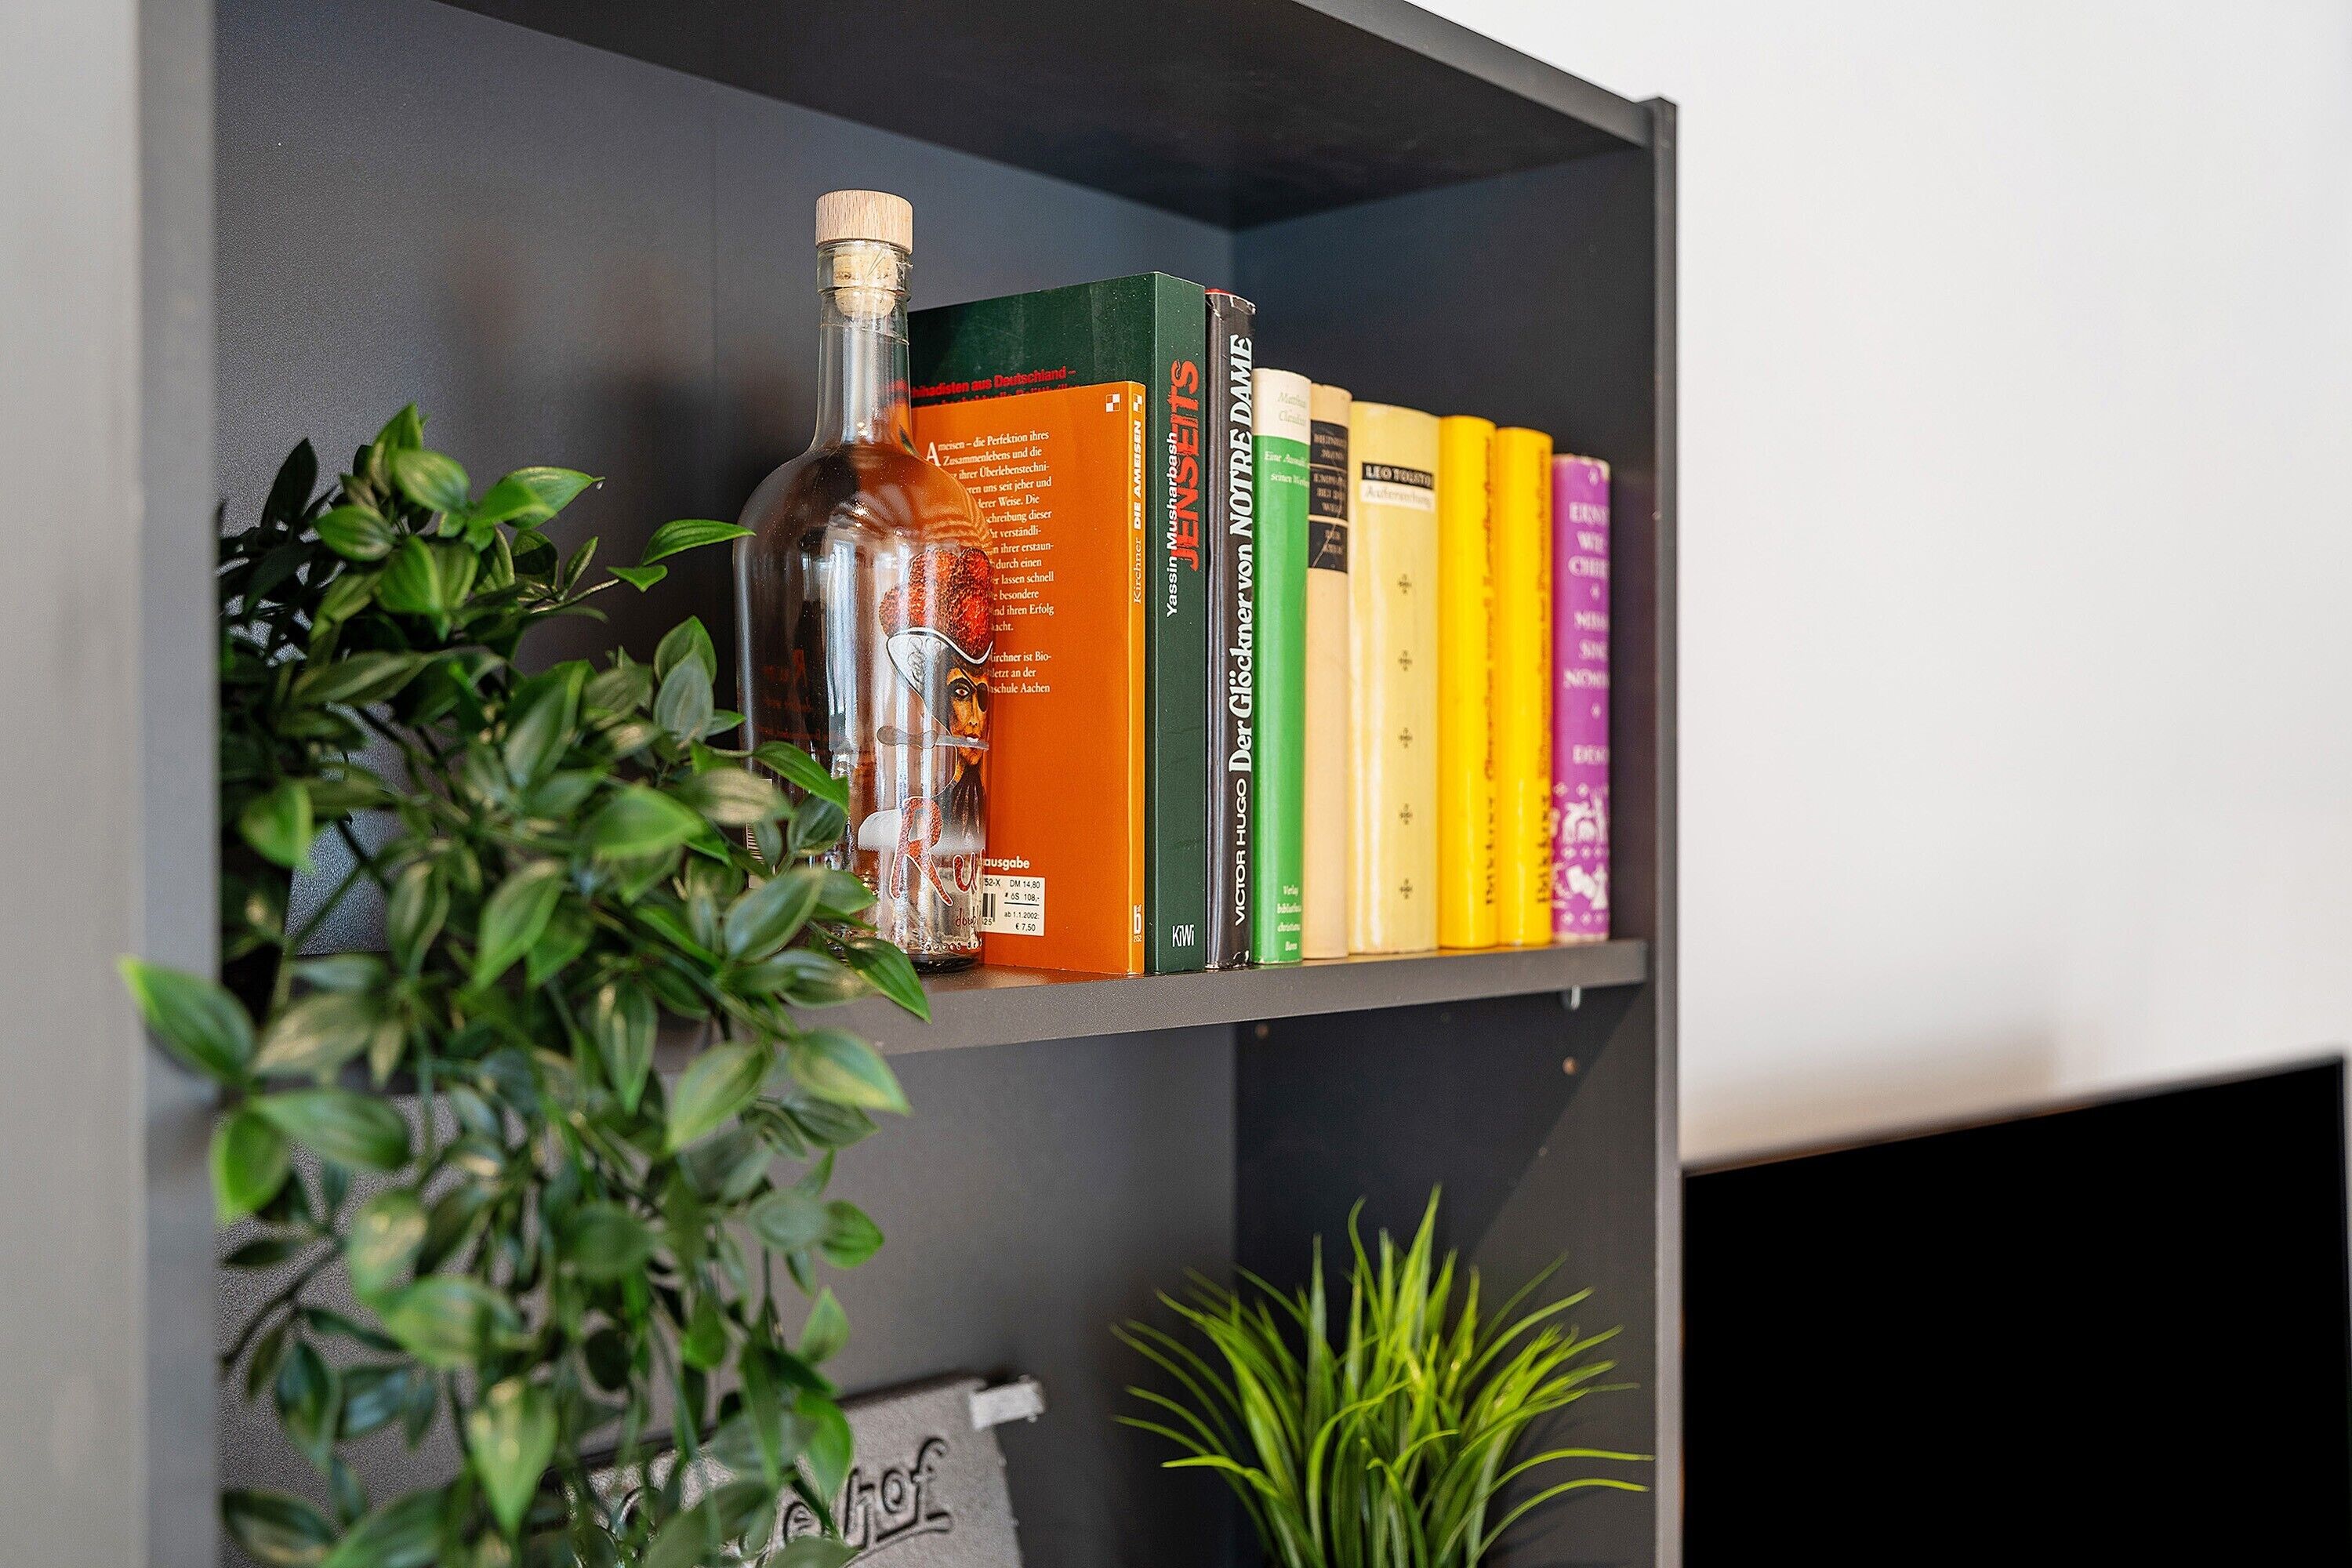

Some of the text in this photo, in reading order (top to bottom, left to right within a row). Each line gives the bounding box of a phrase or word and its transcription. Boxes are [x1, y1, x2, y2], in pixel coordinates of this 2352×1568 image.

[971, 379, 992, 392] aus
[993, 365, 1067, 389] Deutschland
[973, 437, 985, 448] die
[987, 432, 1028, 446] Perfektion
[1029, 430, 1050, 441] ihres
[942, 446, 1043, 466] Zusammenlebens und die
[958, 470, 978, 480] ihrer
[979, 460, 1050, 478] Überlebenstechni-
[1167, 358, 1200, 572] JENSEITS
[1365, 464, 1392, 480] LEO
[983, 485, 997, 493] uns
[999, 481, 1013, 492] seit
[1014, 478, 1035, 492] jeher
[1036, 476, 1052, 488] und
[998, 495, 1024, 507] Weise.
[1025, 494, 1040, 505] Die
[1028, 510, 1052, 521] dieser
[1132, 420, 1142, 604] Kirchner DIE AMEISEN
[1000, 524, 1042, 539] verständli-
[1166, 430, 1178, 619] Yassin Musharbash
[1000, 543, 1020, 554] ihrer
[1021, 543, 1054, 552] erstaun-
[1229, 334, 1253, 772] Der Glöckner von NOTRE DAME
[996, 557, 1019, 569] durch
[1020, 557, 1042, 568] einen
[1001, 574, 1025, 585] lassen
[1026, 571, 1054, 583] schnell
[1000, 588, 1040, 601] besondere
[1007, 604, 1028, 615] ihren
[1029, 602, 1054, 616] Erfolg
[1023, 651, 1033, 662] ist
[1034, 650, 1052, 662] Bio-
[1022, 666, 1036, 677] der
[1020, 682, 1051, 693] Aachen
[1235, 778, 1247, 927] VICTOR HUGO
[984, 855, 1030, 871] ausgabe
[1022, 880, 1040, 888] 14,80
[1172, 924, 1195, 948] KiWi
